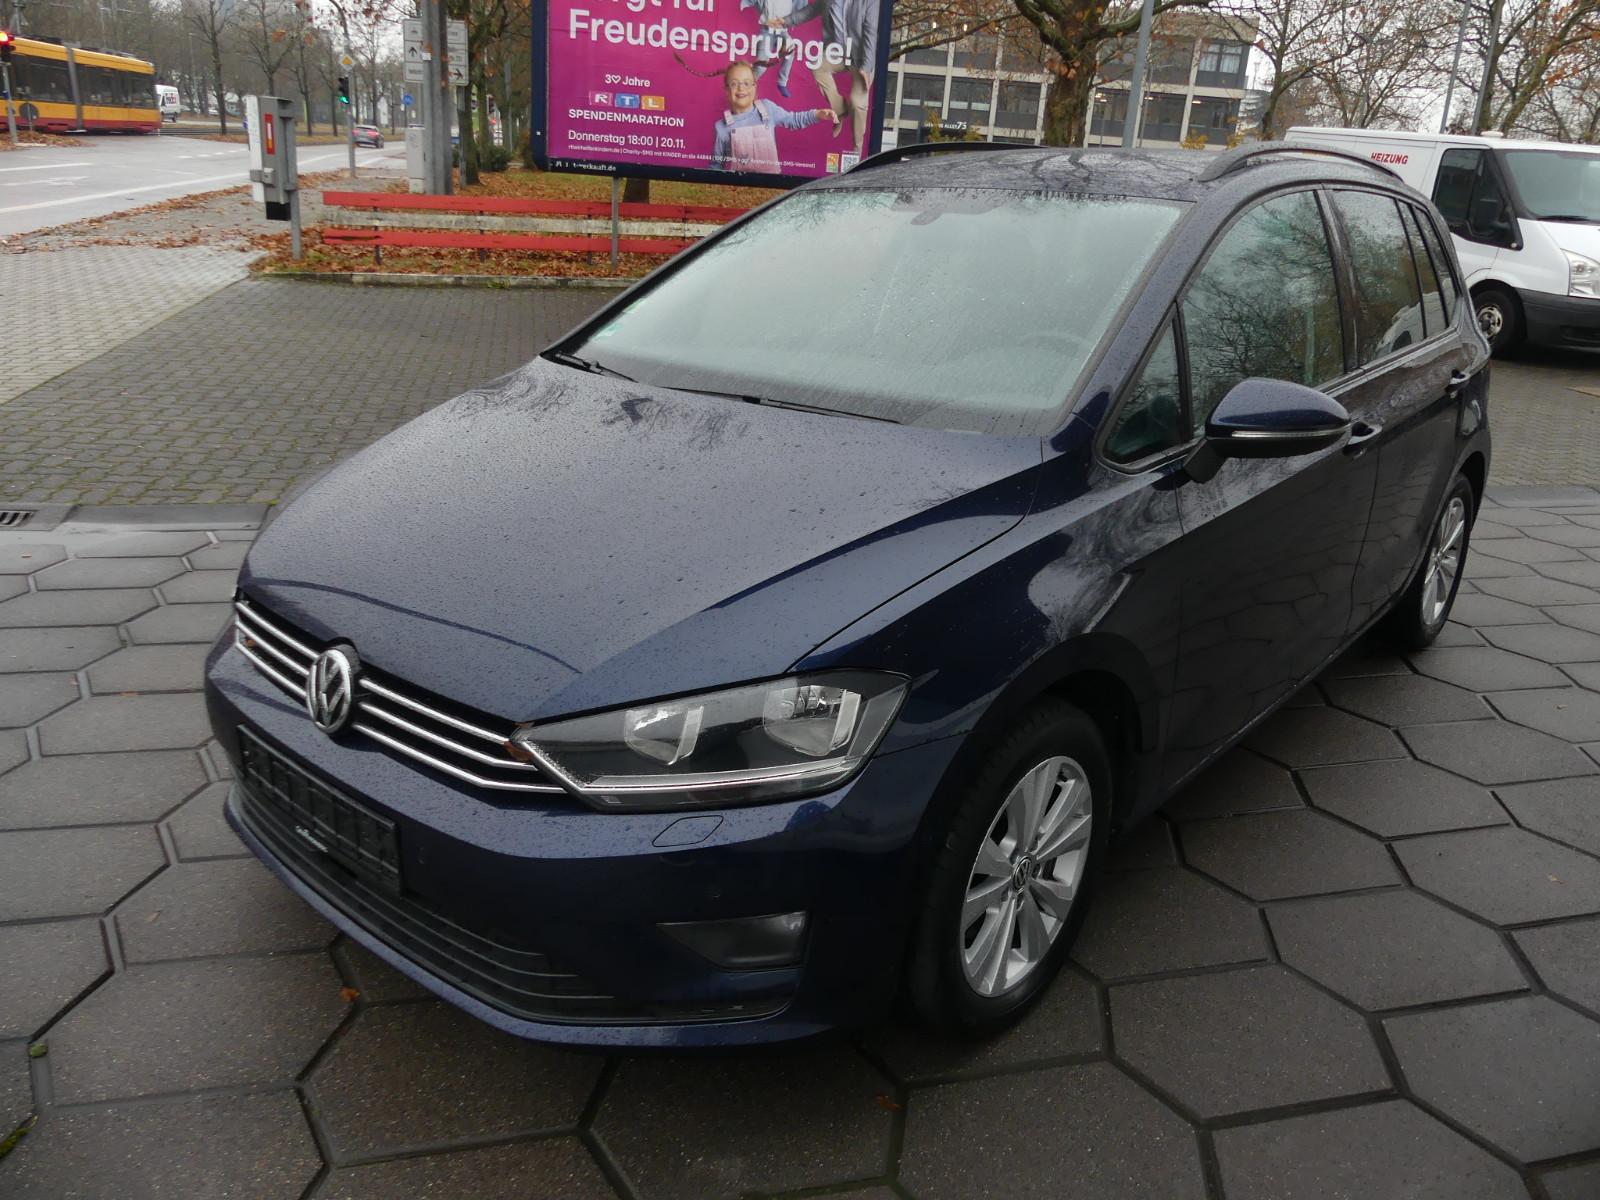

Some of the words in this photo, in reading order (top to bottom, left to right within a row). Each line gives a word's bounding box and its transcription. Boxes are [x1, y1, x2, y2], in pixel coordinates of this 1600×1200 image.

[569, 8, 853, 69] Freudensprünge!
[622, 76, 650, 87] Jahre
[594, 93, 660, 108] RTL
[568, 109, 684, 127] SPENDENMARATHON
[568, 130, 625, 145] Donnerstag
[627, 135, 653, 146] 18:00
[660, 137, 686, 149] 20.11.
[1370, 152, 1409, 165] HEIZUNG
